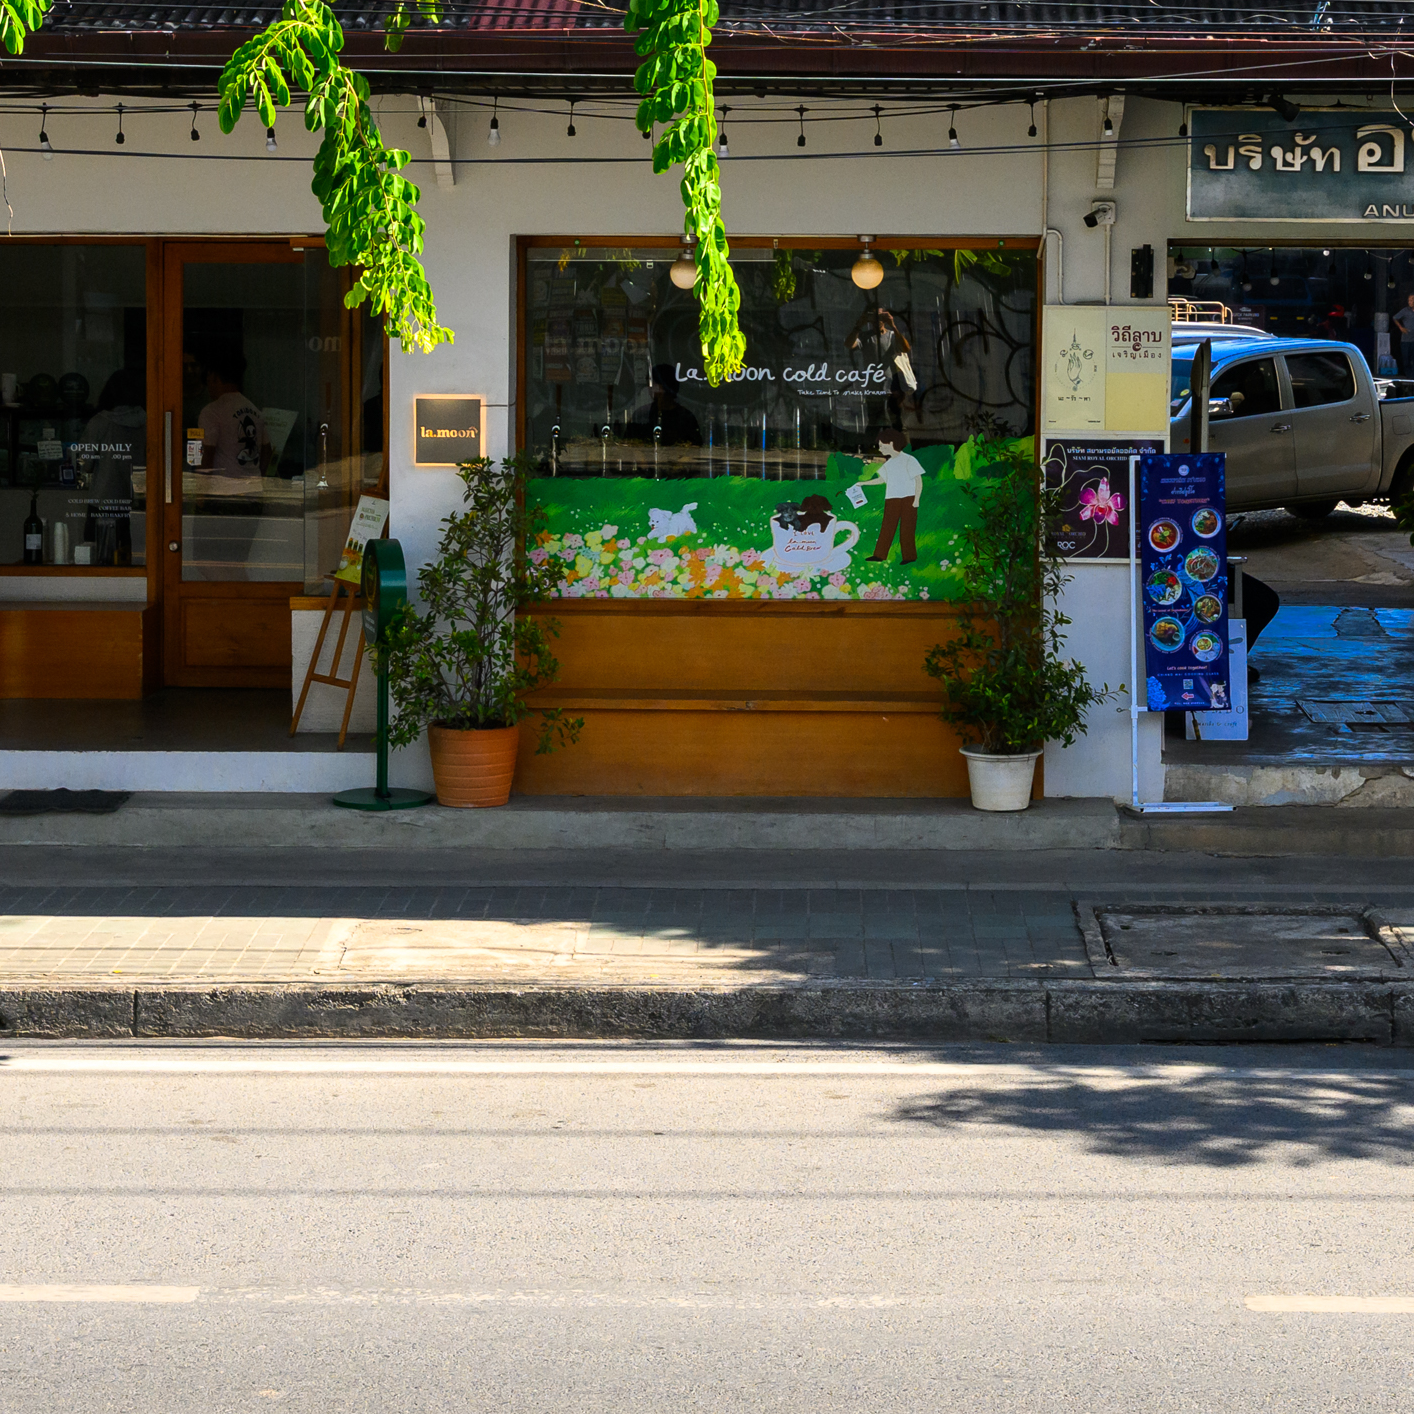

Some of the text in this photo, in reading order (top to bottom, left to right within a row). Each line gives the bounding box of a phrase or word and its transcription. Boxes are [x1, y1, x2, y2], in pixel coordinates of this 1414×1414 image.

[1203, 134, 1341, 172] บริษัท
[1112, 350, 1163, 361] เจริญเมือง
[782, 362, 831, 383] cold
[834, 363, 886, 388] café
[420, 426, 479, 439] la.moon
[70, 443, 99, 452] OPEN
[101, 443, 133, 452] DAILY
